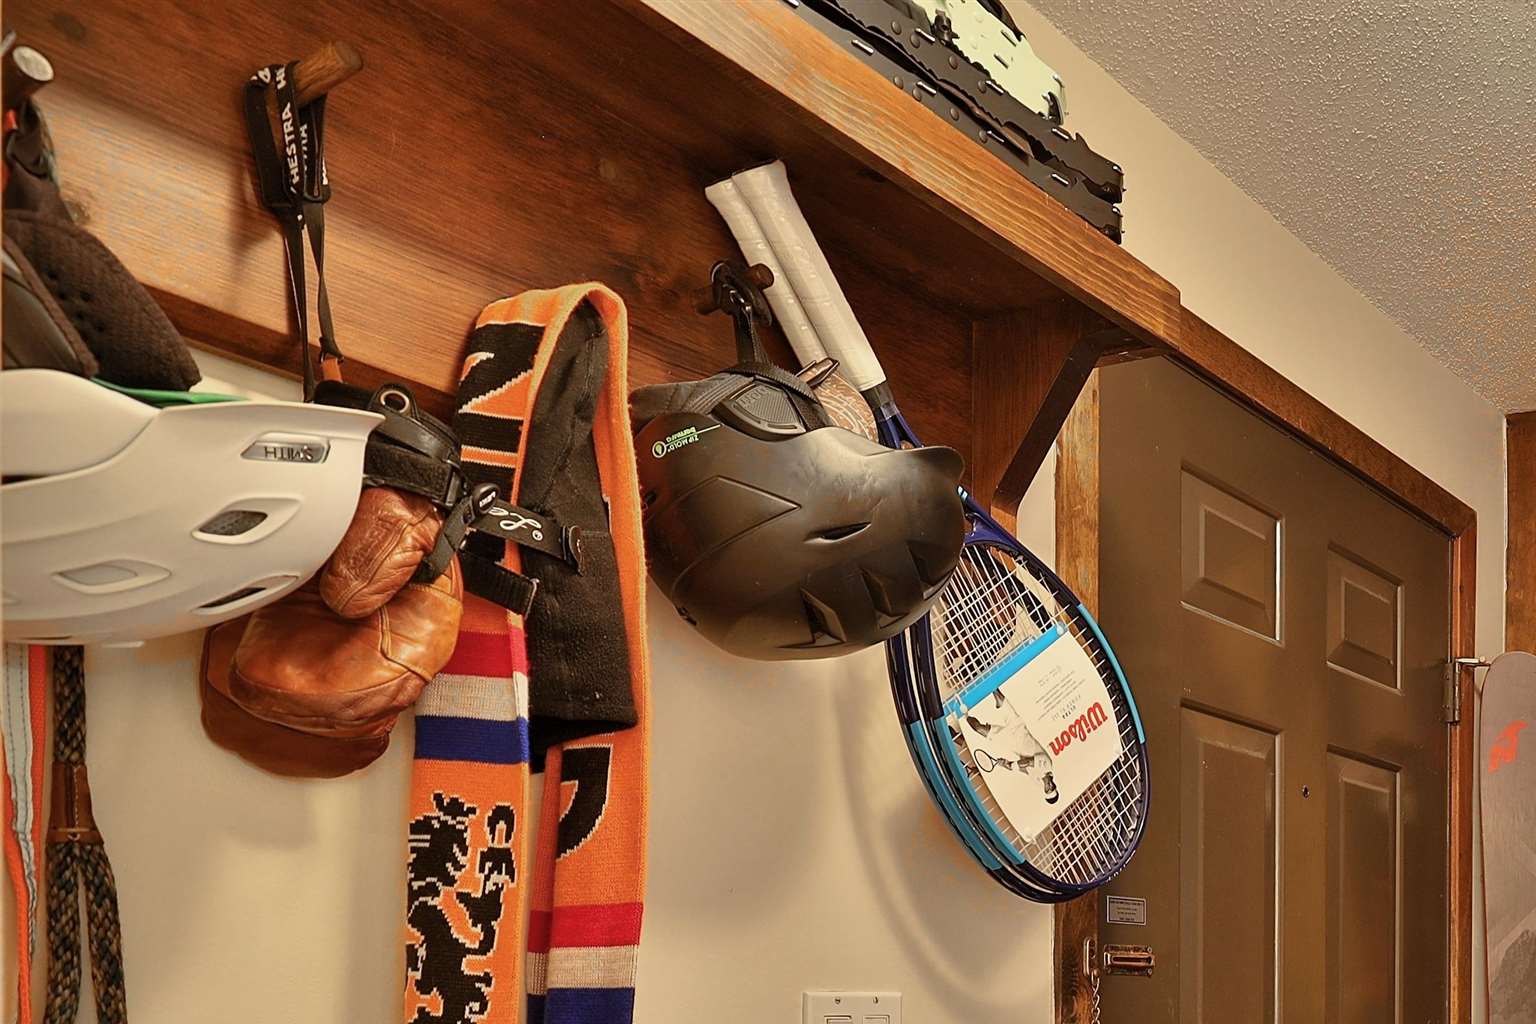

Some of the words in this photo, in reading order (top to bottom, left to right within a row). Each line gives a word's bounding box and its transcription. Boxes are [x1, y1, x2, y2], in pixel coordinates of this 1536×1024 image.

[281, 102, 300, 185] HESTRA
[264, 445, 314, 462] SMITH
[1049, 702, 1108, 756] Wilson
